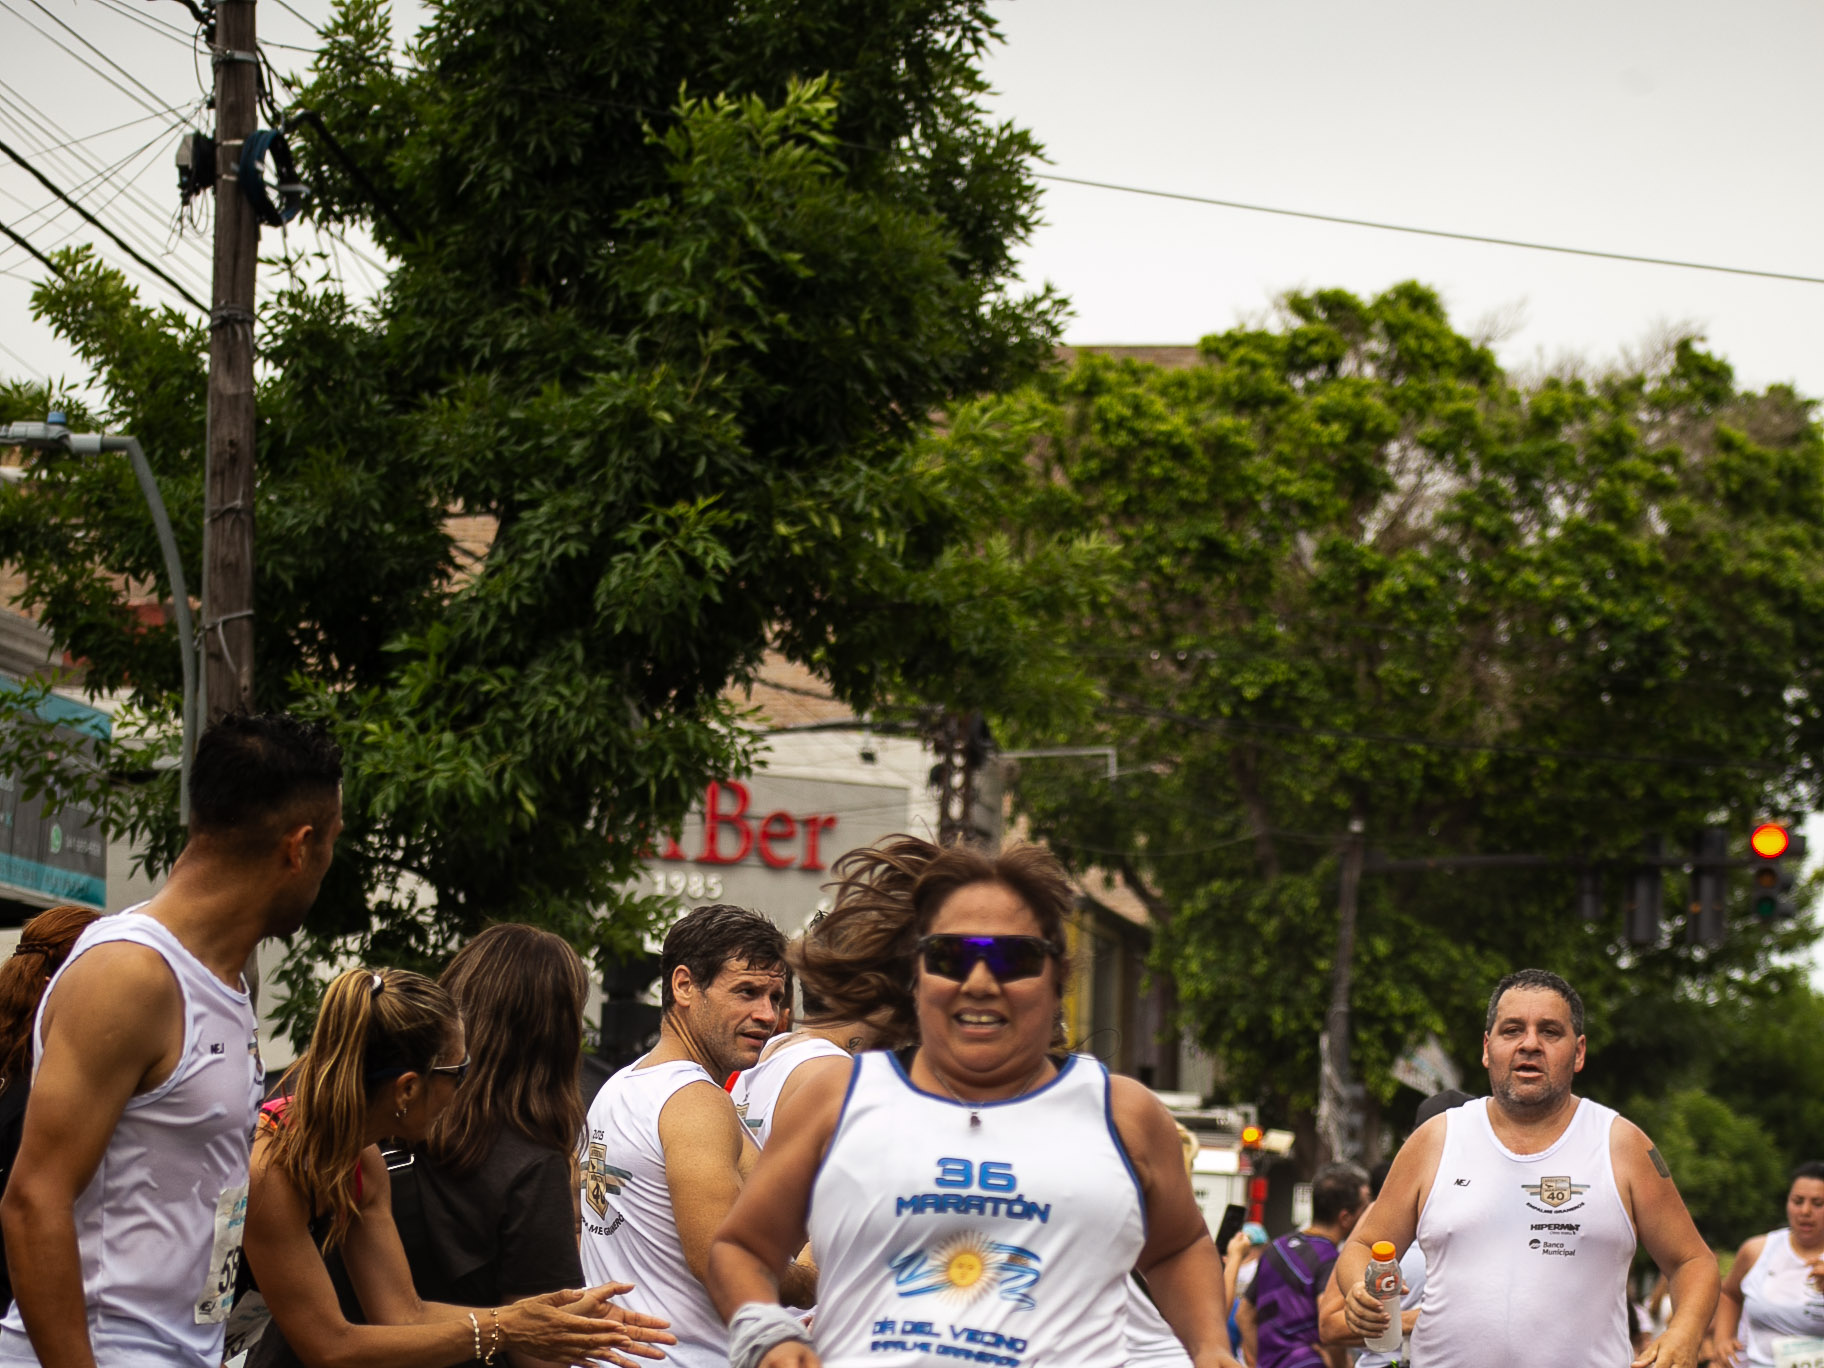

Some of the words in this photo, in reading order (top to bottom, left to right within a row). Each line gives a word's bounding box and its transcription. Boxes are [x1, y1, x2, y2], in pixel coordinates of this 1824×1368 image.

[696, 780, 838, 869] Ber
[653, 870, 724, 899] 1985
[935, 1157, 1017, 1193] 36
[896, 1193, 1051, 1224] MARATÓN
[1547, 1193, 1565, 1201] 40
[1542, 1249, 1576, 1257] Municipal
